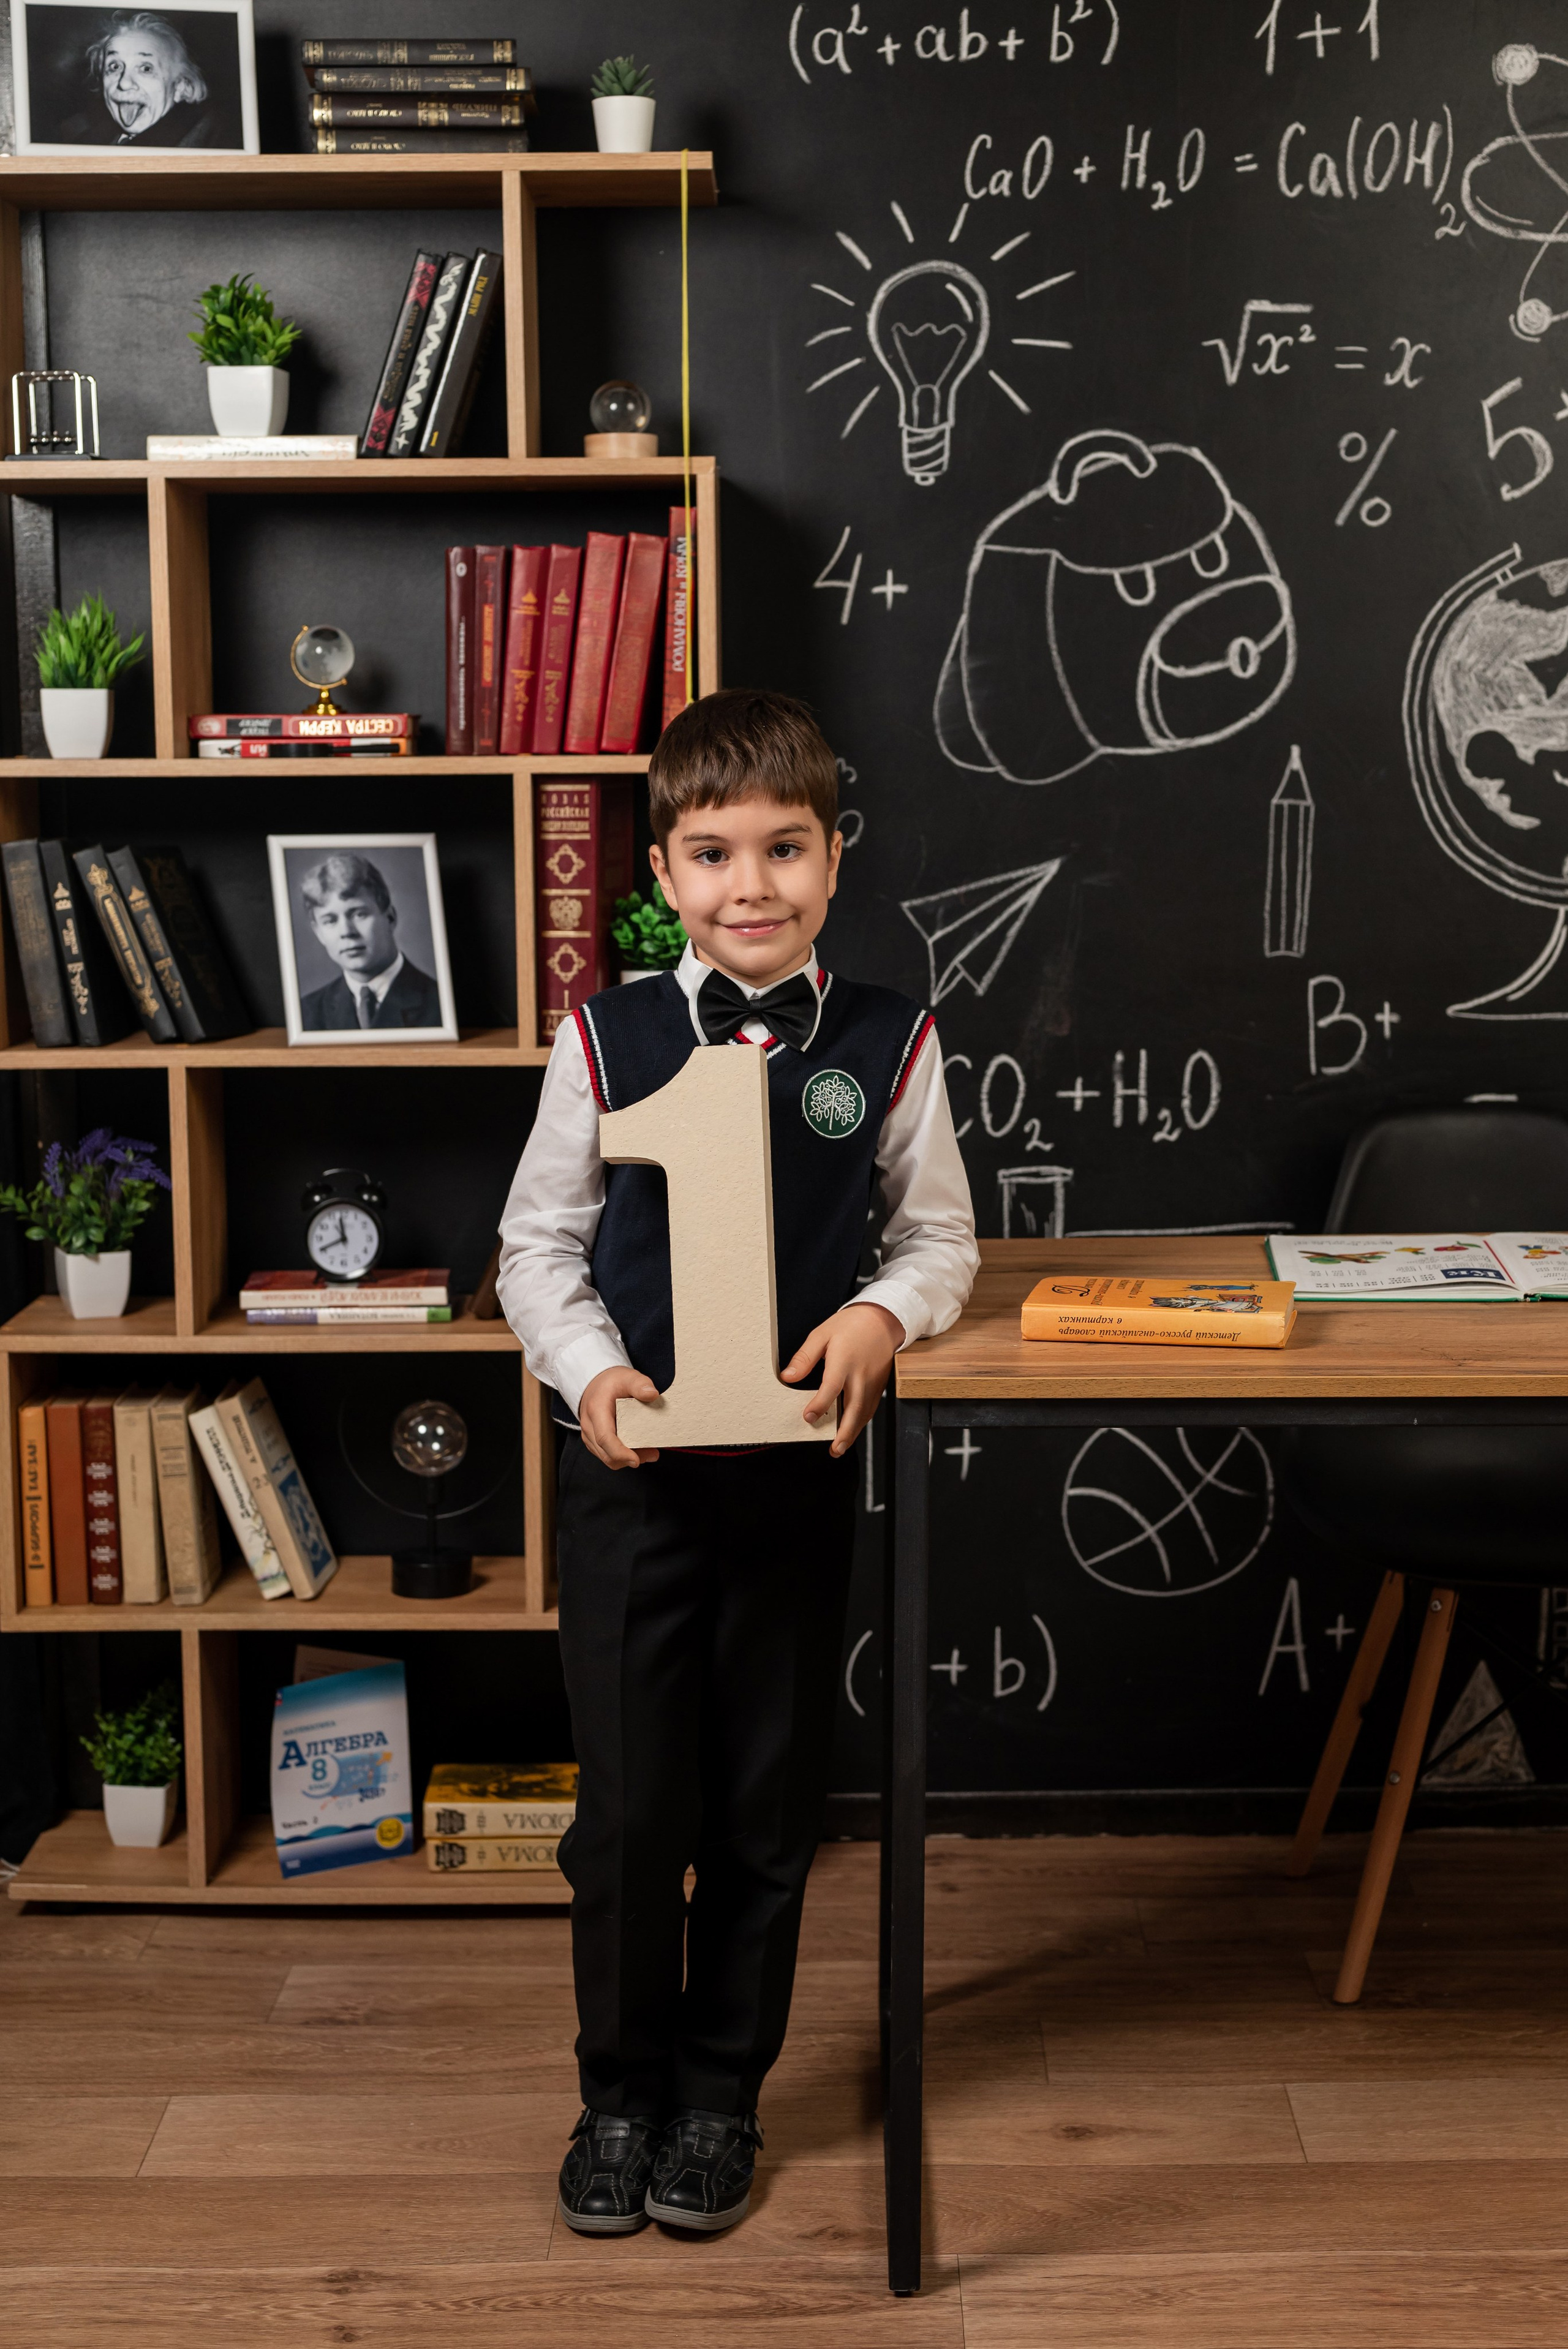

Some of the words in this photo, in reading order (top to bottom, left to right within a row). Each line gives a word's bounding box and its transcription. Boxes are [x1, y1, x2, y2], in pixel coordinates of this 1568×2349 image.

[671, 592, 687, 671] РОМАНОВЫ
[298, 718, 342, 736] КЕРРИ
[345, 718, 394, 734] СЕСТРА
[600, 1044, 838, 1449] 1
[1058, 1315, 1114, 1324] картинках
[1058, 1326, 1096, 1335] словарь
[1099, 1330, 1193, 1340] русско-английский
[1195, 1332, 1241, 1341] Детский
[1259, 1576, 1355, 1696] A+
[278, 1731, 389, 1770] АЛГЕБРА
[311, 1759, 326, 1781] 8
[496, 1845, 555, 1864] ЮМА
